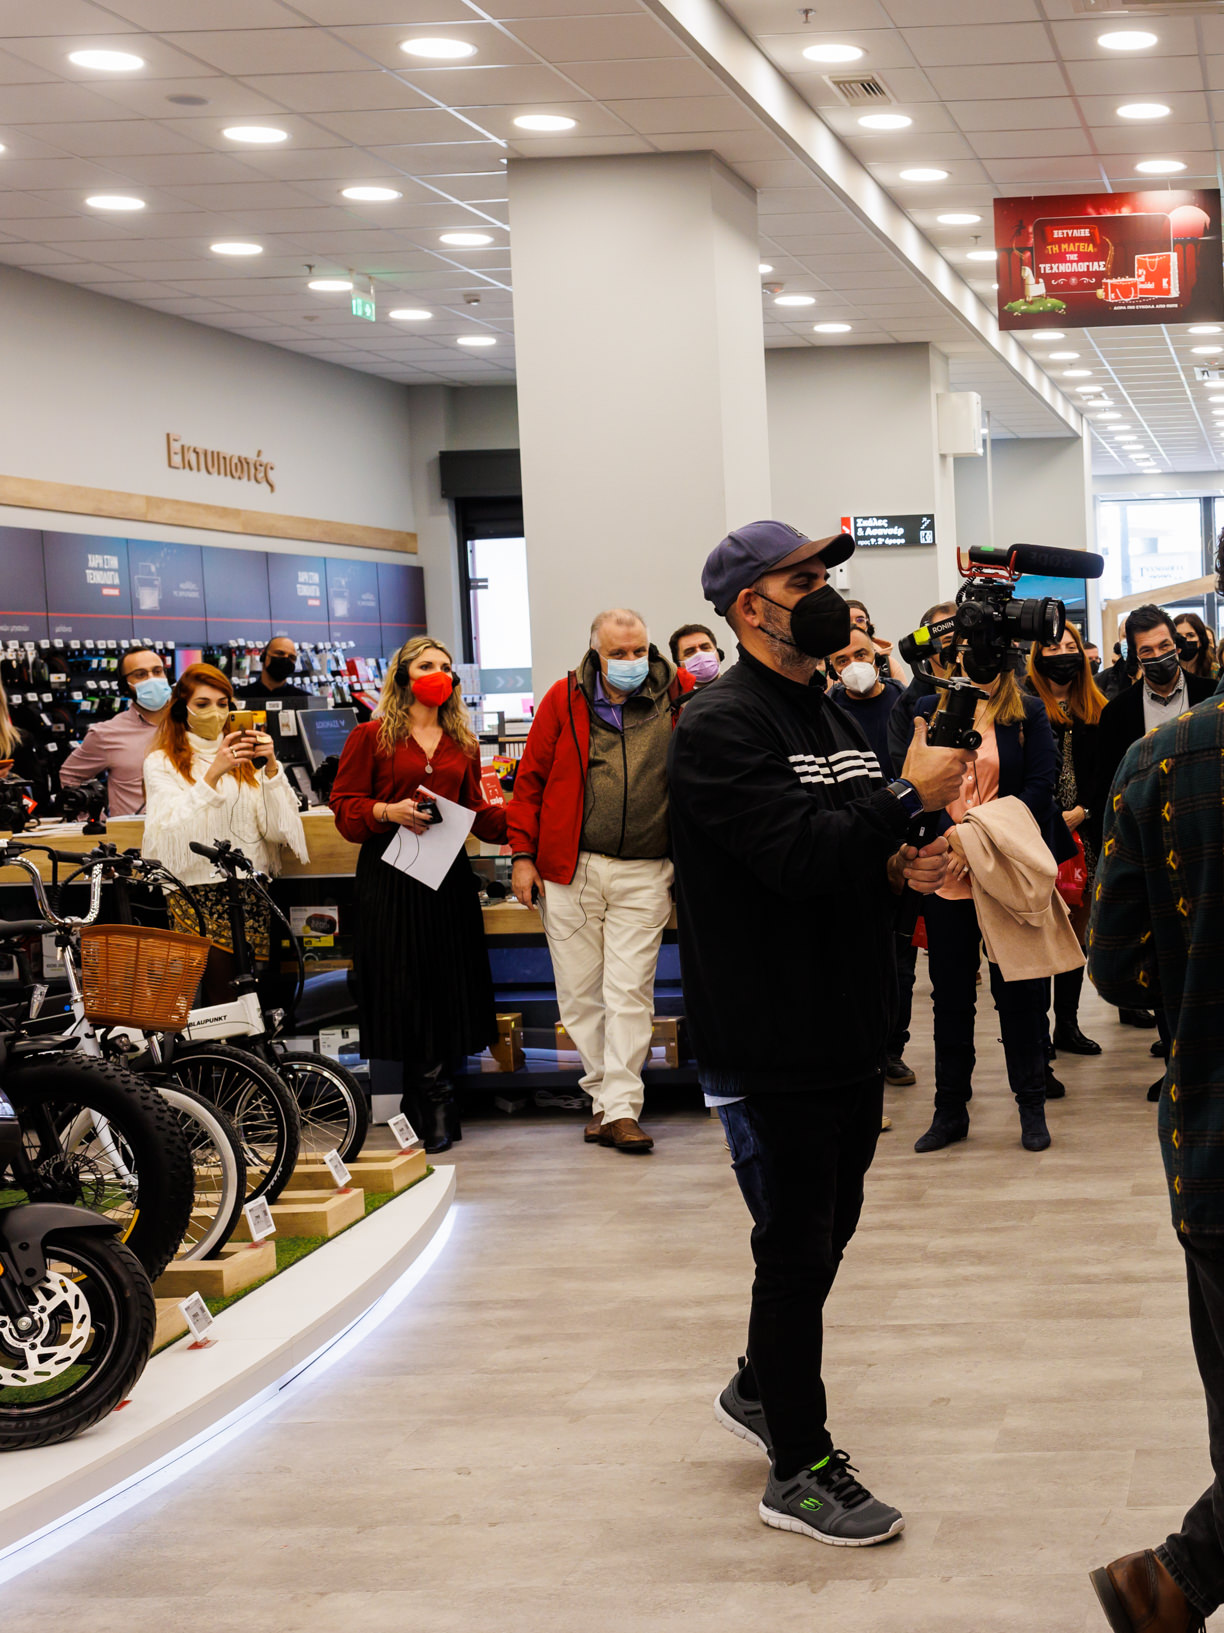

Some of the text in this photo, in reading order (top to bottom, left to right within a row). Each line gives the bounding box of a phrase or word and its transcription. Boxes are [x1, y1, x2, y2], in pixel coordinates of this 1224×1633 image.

[1053, 229, 1090, 238] ΞΕΤΥΛΙΞΕ
[1046, 243, 1094, 255] ΤΗ ΜΑΓΕΙΑ
[1039, 261, 1106, 274] ΤΕΧΝΟΛΟΓΙΑΣ
[166, 432, 275, 494] Εκτυπωτές
[932, 620, 955, 634] RONIN
[188, 1014, 228, 1027] BLAUPUNKT
